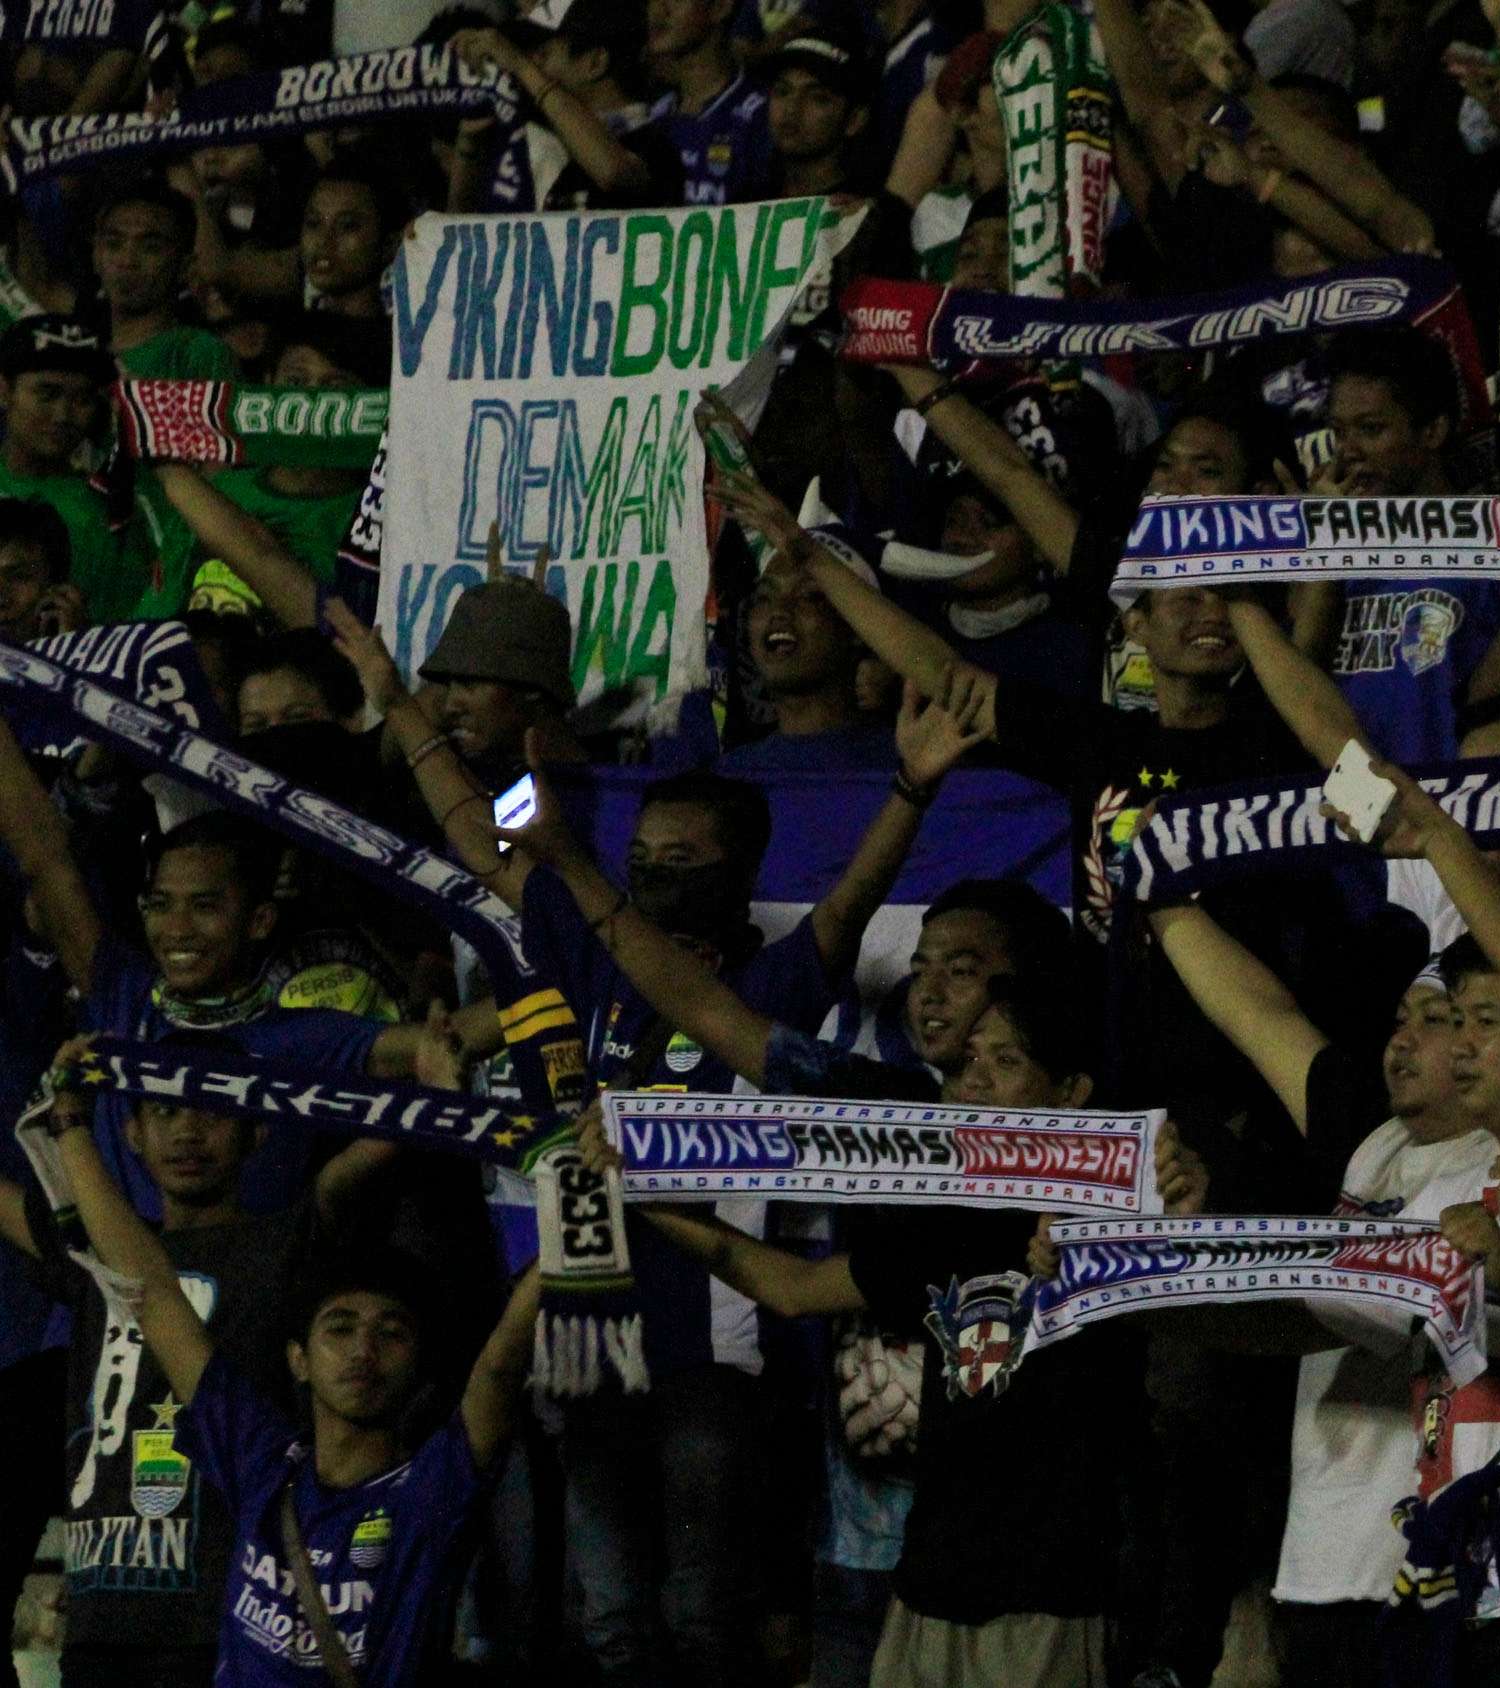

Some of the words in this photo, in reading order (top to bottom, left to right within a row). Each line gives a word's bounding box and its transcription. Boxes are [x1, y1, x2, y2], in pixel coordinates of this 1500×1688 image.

[397, 216, 621, 383] VIKING
[953, 275, 1411, 359] VIKING
[456, 390, 690, 561] DEMAK
[1304, 500, 1494, 547] FARMASI
[1318, 554, 1485, 567] TANDANG
[616, 1101, 783, 1115] SUPPORTER
[812, 1105, 934, 1120] PERSIB
[966, 1115, 1143, 1131] BANDUNG
[625, 1122, 792, 1167] VIKING
[787, 1123, 964, 1171] FARMASI
[955, 1133, 1138, 1184] INDONESIA
[626, 1176, 787, 1189] KANDANG
[803, 1177, 950, 1191] TANDANG
[964, 1182, 1137, 1208] MANGPRANG
[1193, 1220, 1308, 1231] PERSIB
[1187, 1273, 1322, 1290] TANDANG
